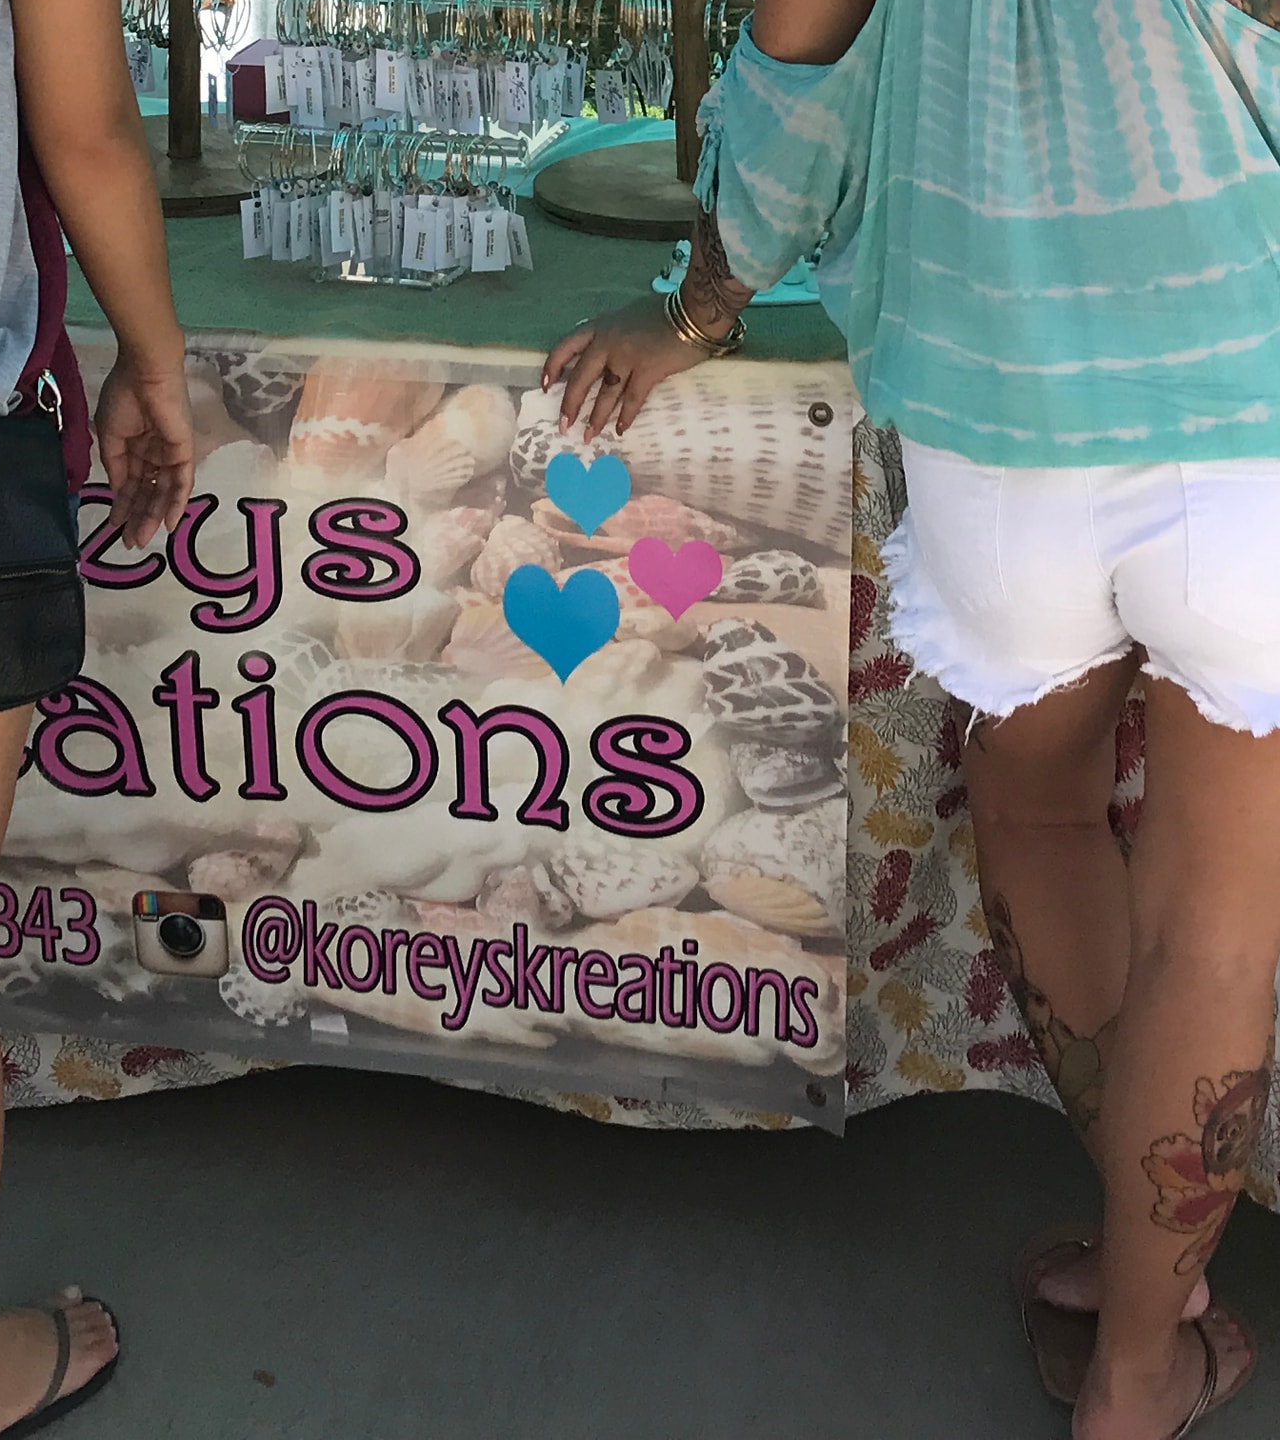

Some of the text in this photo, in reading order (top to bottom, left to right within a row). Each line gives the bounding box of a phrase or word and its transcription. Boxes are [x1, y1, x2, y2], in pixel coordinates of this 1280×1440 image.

[76, 483, 422, 633] eys
[32, 649, 706, 839] ations
[242, 895, 820, 1049] @koreyskreations
